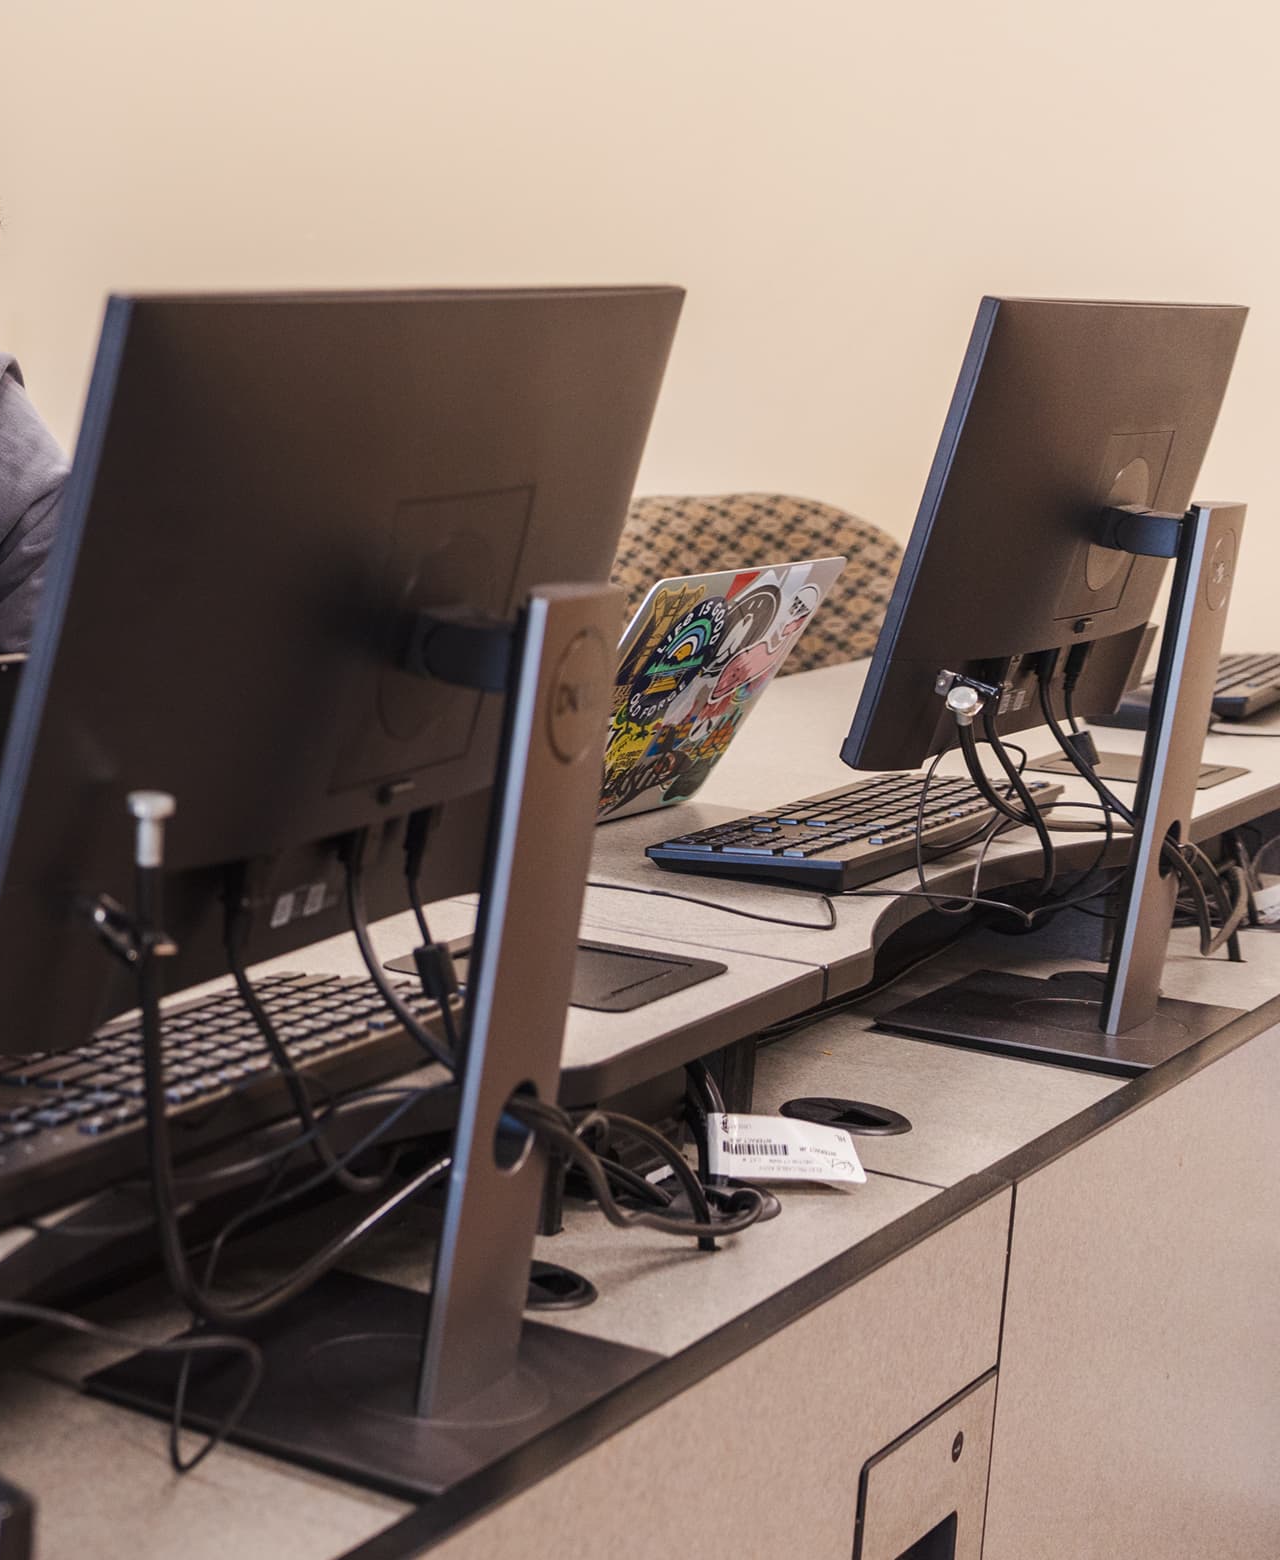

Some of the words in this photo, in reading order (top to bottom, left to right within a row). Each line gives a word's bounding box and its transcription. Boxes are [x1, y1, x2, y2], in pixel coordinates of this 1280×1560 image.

[699, 601, 714, 616] IS
[709, 602, 726, 645] GOOD
[630, 693, 642, 717] OLD
